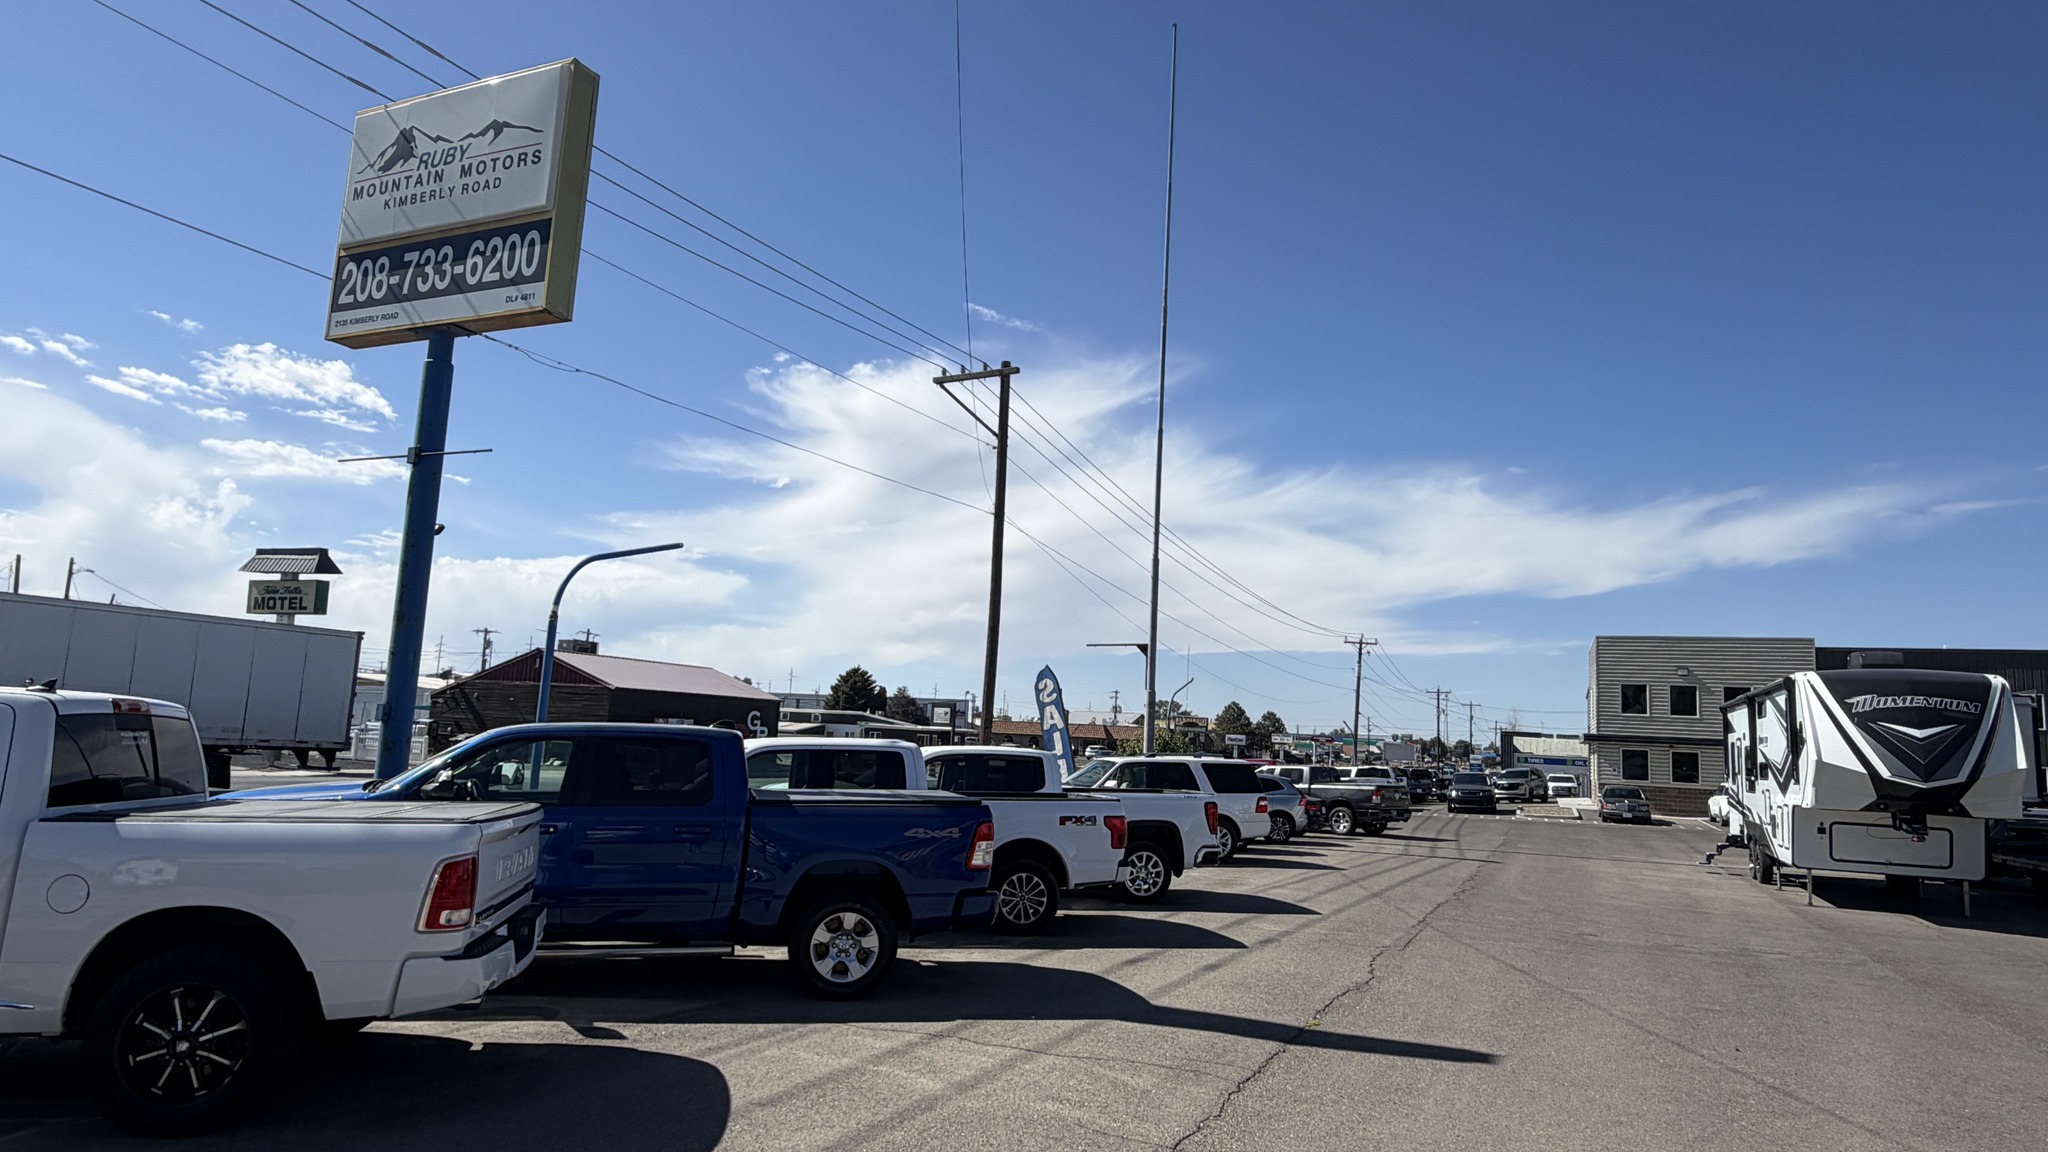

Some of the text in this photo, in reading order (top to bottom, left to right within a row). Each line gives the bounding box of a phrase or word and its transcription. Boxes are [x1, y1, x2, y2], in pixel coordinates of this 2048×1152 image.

[416, 143, 472, 172] RUBY
[352, 149, 542, 202] MOUNTAIN MOTORS
[383, 177, 502, 210] KIMBERLY ROAD
[337, 229, 541, 305] 208-733-6200
[349, 314, 380, 325] KIMBERLY
[380, 311, 399, 321] ROAD
[253, 596, 308, 610] MOTEL
[1059, 815, 1097, 826] FX4
